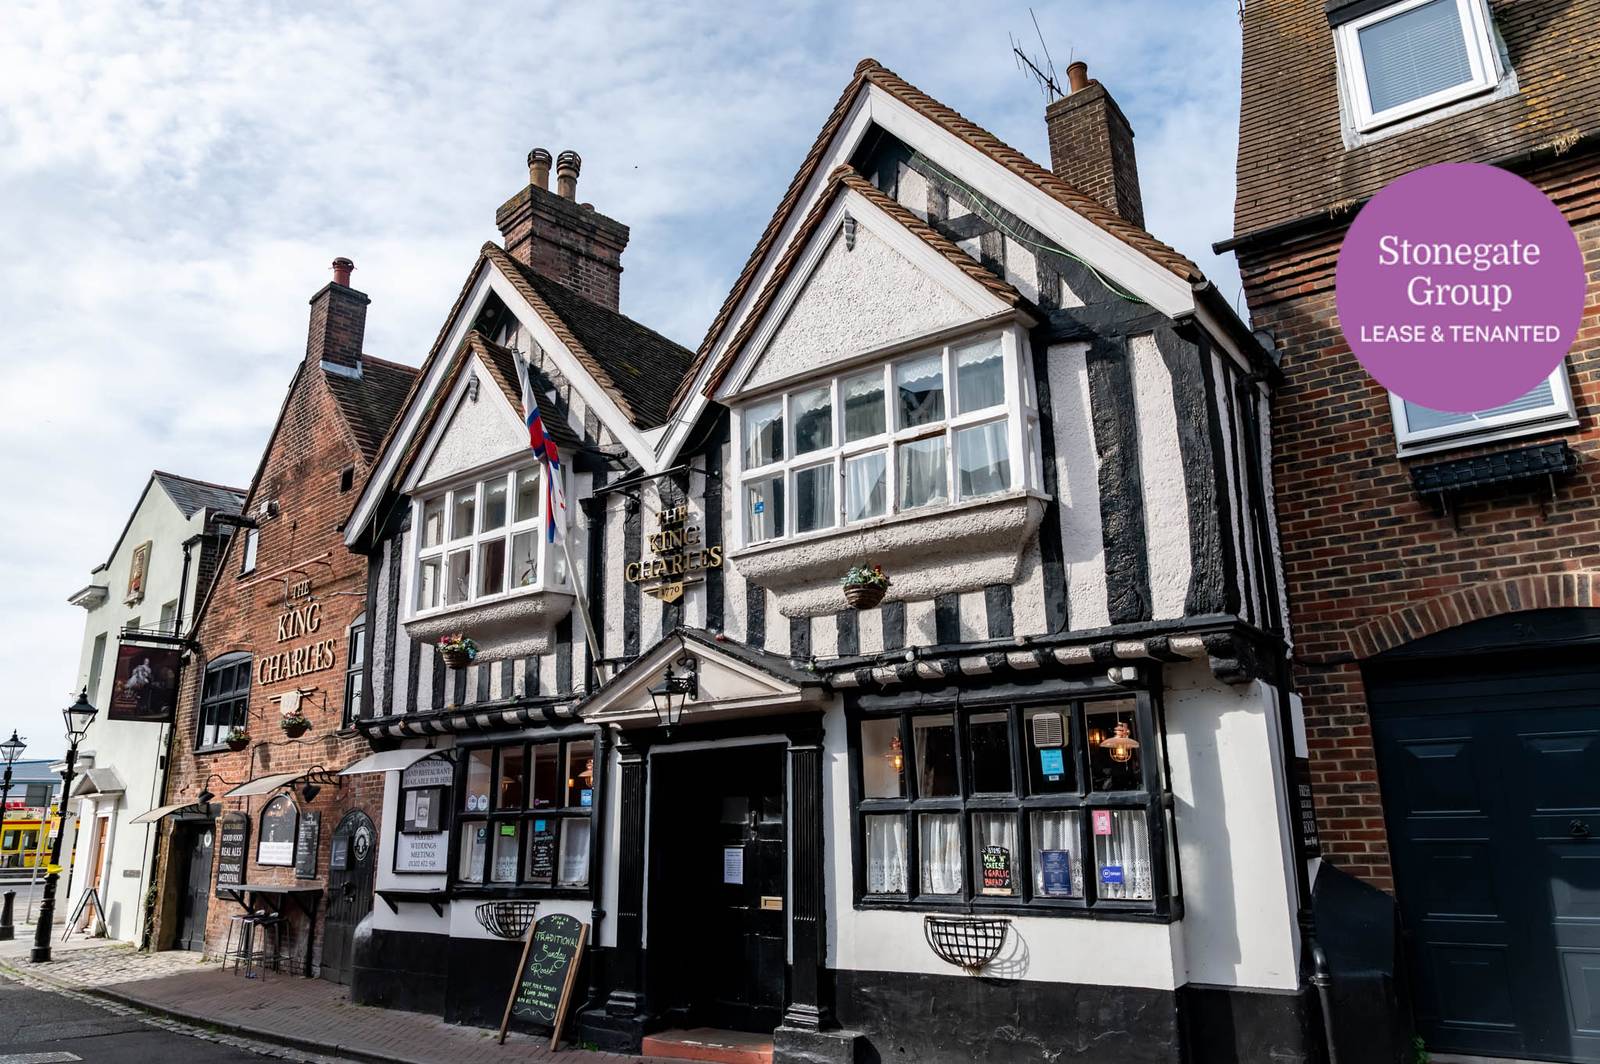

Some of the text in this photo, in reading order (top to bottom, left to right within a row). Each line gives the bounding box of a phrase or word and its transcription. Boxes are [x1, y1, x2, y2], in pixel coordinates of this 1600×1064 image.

[655, 505, 688, 526] THE
[647, 526, 701, 554] KING
[625, 546, 723, 582] CHARLES
[291, 580, 311, 599] THE
[277, 602, 321, 643] KING
[258, 638, 336, 685] CHARLES
[221, 847, 242, 856] REAL ALES
[410, 842, 437, 850] WEDDINGS
[410, 851, 435, 859] MEETINGS
[219, 864, 240, 872] STUNNING
[988, 869, 1010, 878] GARLIC
[984, 878, 1004, 887] BREAD
[534, 930, 578, 948] TRADITIONAL
[534, 943, 566, 969] Sunday
[531, 962, 558, 979] Roast
